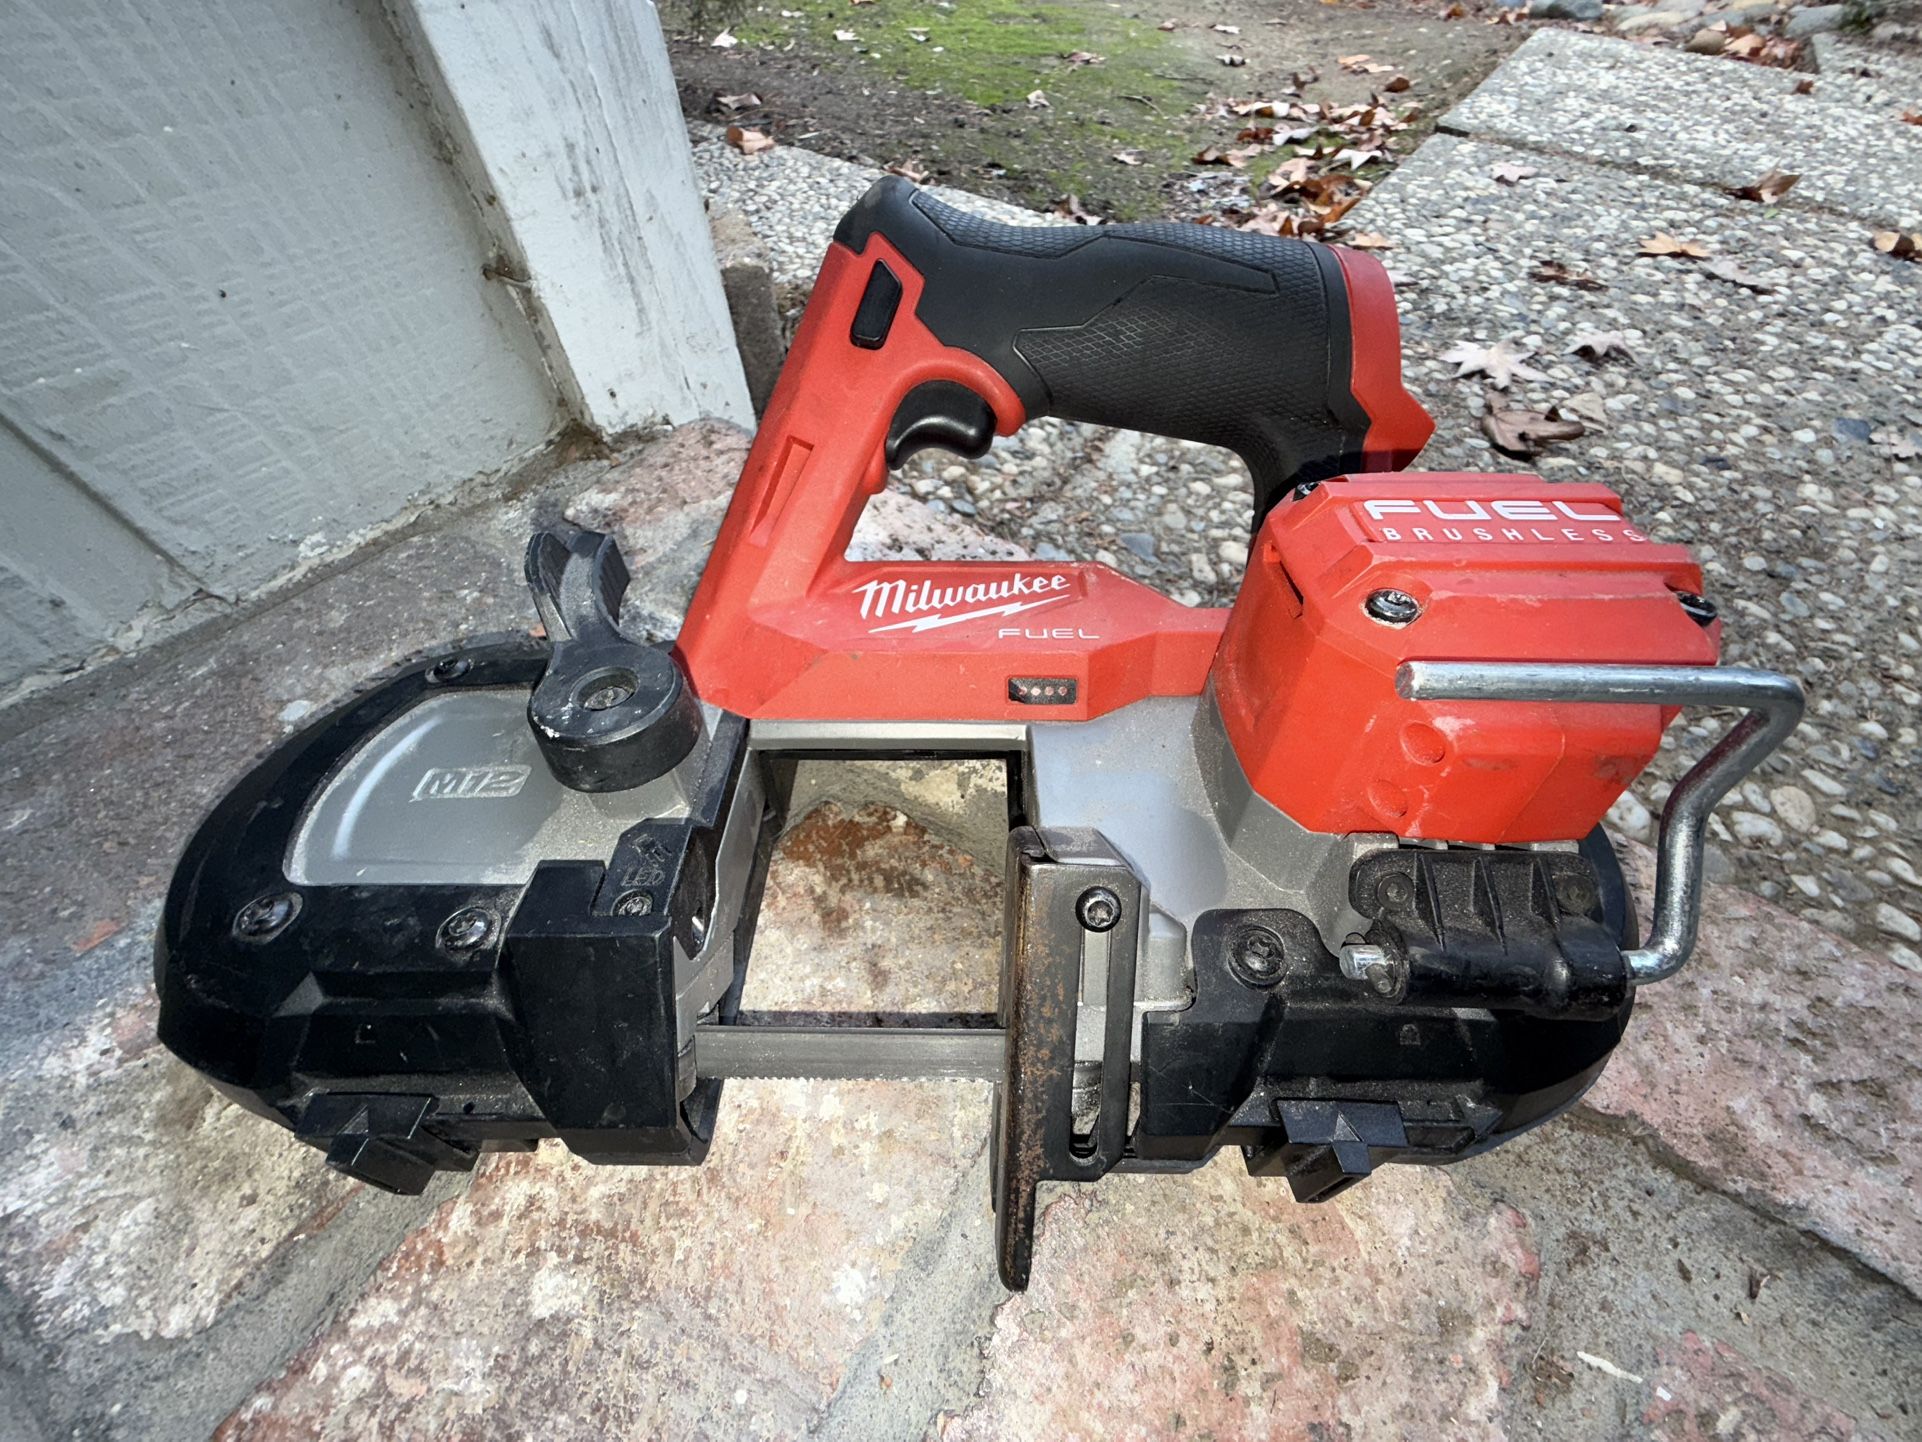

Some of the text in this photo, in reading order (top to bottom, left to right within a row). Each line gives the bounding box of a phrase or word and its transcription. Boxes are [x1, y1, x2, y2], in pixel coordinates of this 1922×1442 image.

[1363, 499, 1621, 521] FUEL
[1381, 527, 1648, 542] BRUSHLESS
[852, 572, 1071, 620] Milwaukee
[997, 628, 1101, 639] FUEL
[416, 767, 529, 797] M12
[621, 866, 666, 887] LED
